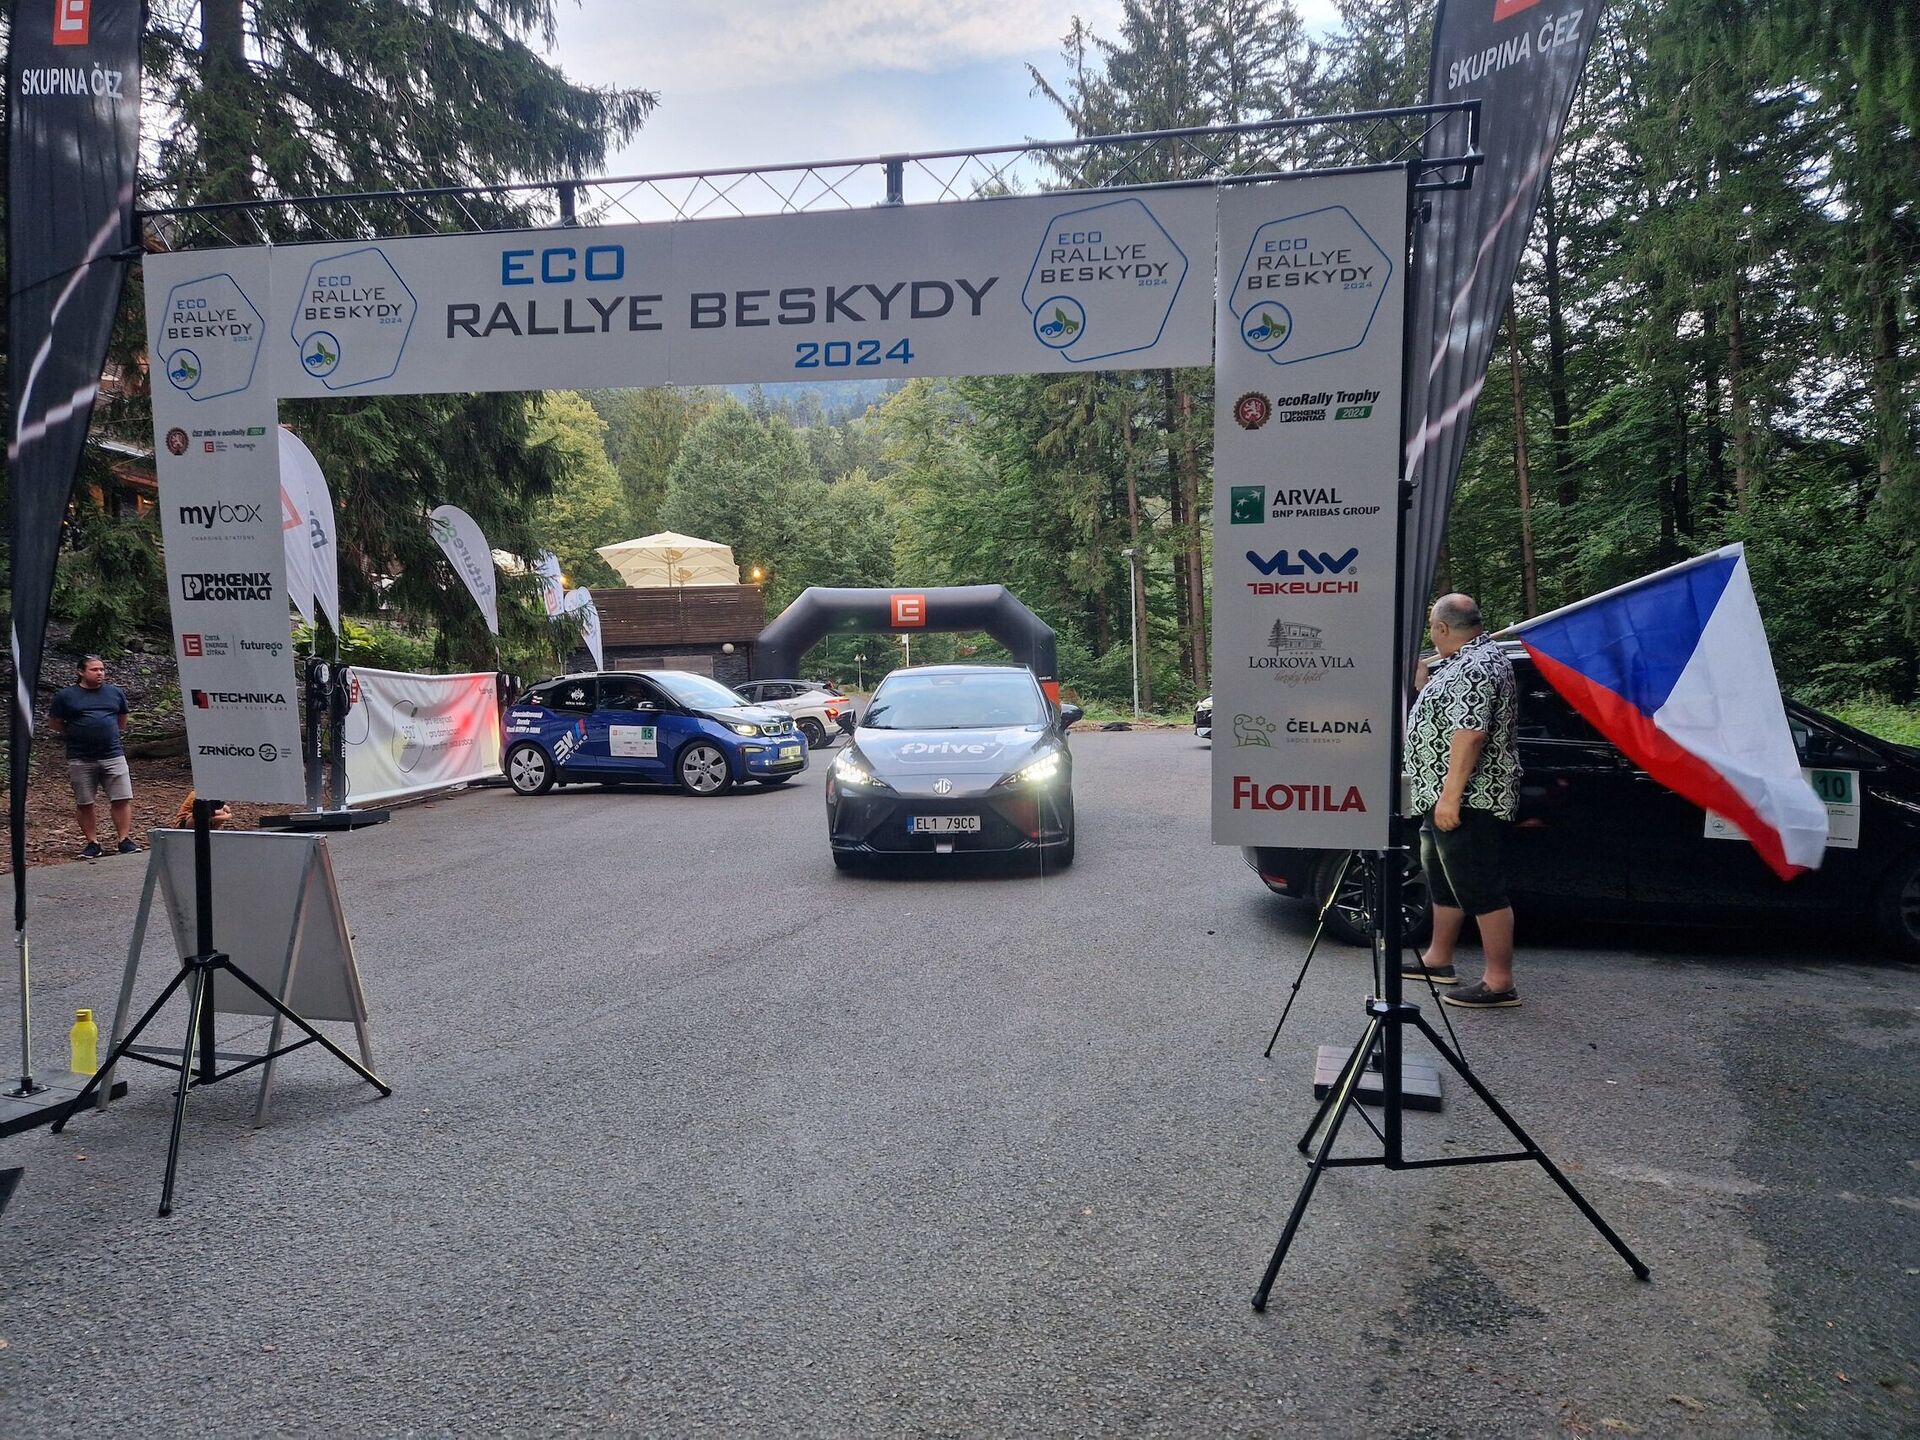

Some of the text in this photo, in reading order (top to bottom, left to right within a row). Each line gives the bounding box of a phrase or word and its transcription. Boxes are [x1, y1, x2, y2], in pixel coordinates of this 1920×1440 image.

[1448, 9, 1583, 90] SKUPINA ČEZ
[21, 62, 124, 99] SKUPINA ČEZ
[1058, 231, 1102, 245] ECO
[1265, 238, 1309, 253] ECO
[1050, 243, 1147, 264] RALLYE
[1257, 249, 1353, 271] RALLYE
[501, 244, 625, 286] ECO
[1040, 262, 1169, 284] BESKYDY
[317, 275, 352, 288] ECO
[1137, 278, 1168, 287] 2024
[1247, 266, 1374, 290] BESKYDY
[1343, 281, 1374, 290] 2024
[176, 298, 207, 310] ECO
[312, 287, 386, 304] RALLYE
[304, 303, 403, 321] BESKYDY
[446, 276, 1000, 338] RALLYE BESKYDY
[173, 308, 237, 324] RALLYE
[167, 322, 253, 339] BESKYDY
[794, 337, 915, 369] 2024
[1277, 388, 1381, 407] ecoRally Trophy
[1341, 406, 1366, 418] 2024
[1272, 487, 1343, 506] ARVAL
[179, 500, 263, 529] mybox
[1272, 505, 1381, 519] BNP PARIBAS GROUP
[204, 586, 273, 601] CONTACT
[240, 640, 283, 657] futurego
[1248, 655, 1356, 669] LORKOVA VILA
[209, 692, 287, 705] TECHNIKA
[1286, 717, 1373, 734] ČELADNÁ
[559, 734, 588, 766] MOTORS
[1232, 775, 1368, 813] FLOTILA
[1818, 776, 1846, 799] 10
[916, 817, 976, 830] EL1 79CC
